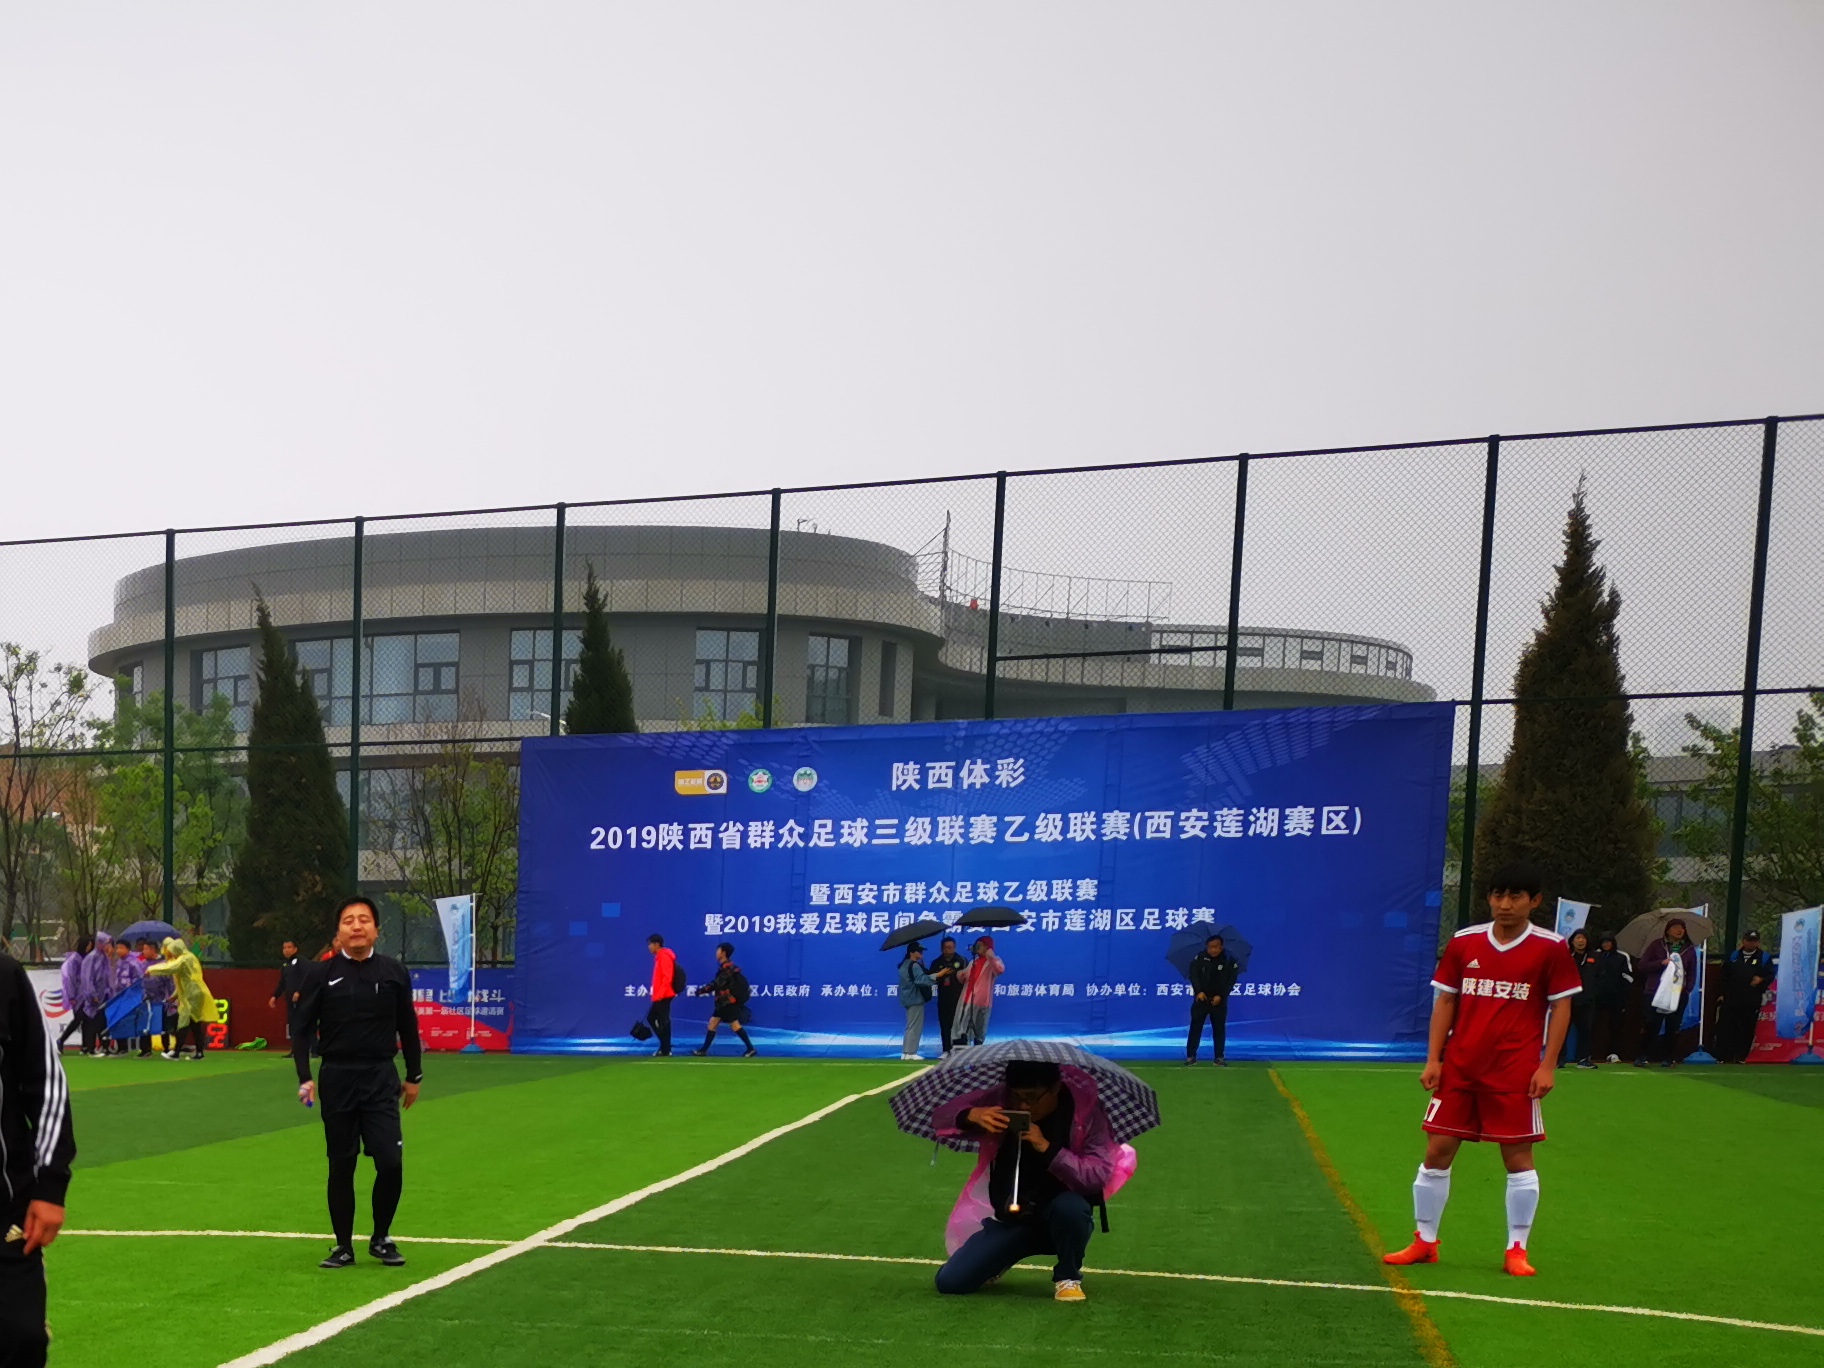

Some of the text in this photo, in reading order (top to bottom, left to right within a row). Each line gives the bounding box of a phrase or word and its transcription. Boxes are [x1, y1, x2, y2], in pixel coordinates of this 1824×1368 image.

[891, 757, 1026, 791] 陕西体彩
[590, 804, 1362, 851] 2019陕西省群众足球三级联赛乙级联赛(西安莲湖赛区)
[809, 878, 1099, 905] 暨西安市群众足球乙级联赛
[1462, 977, 1531, 1000] 陕建安装
